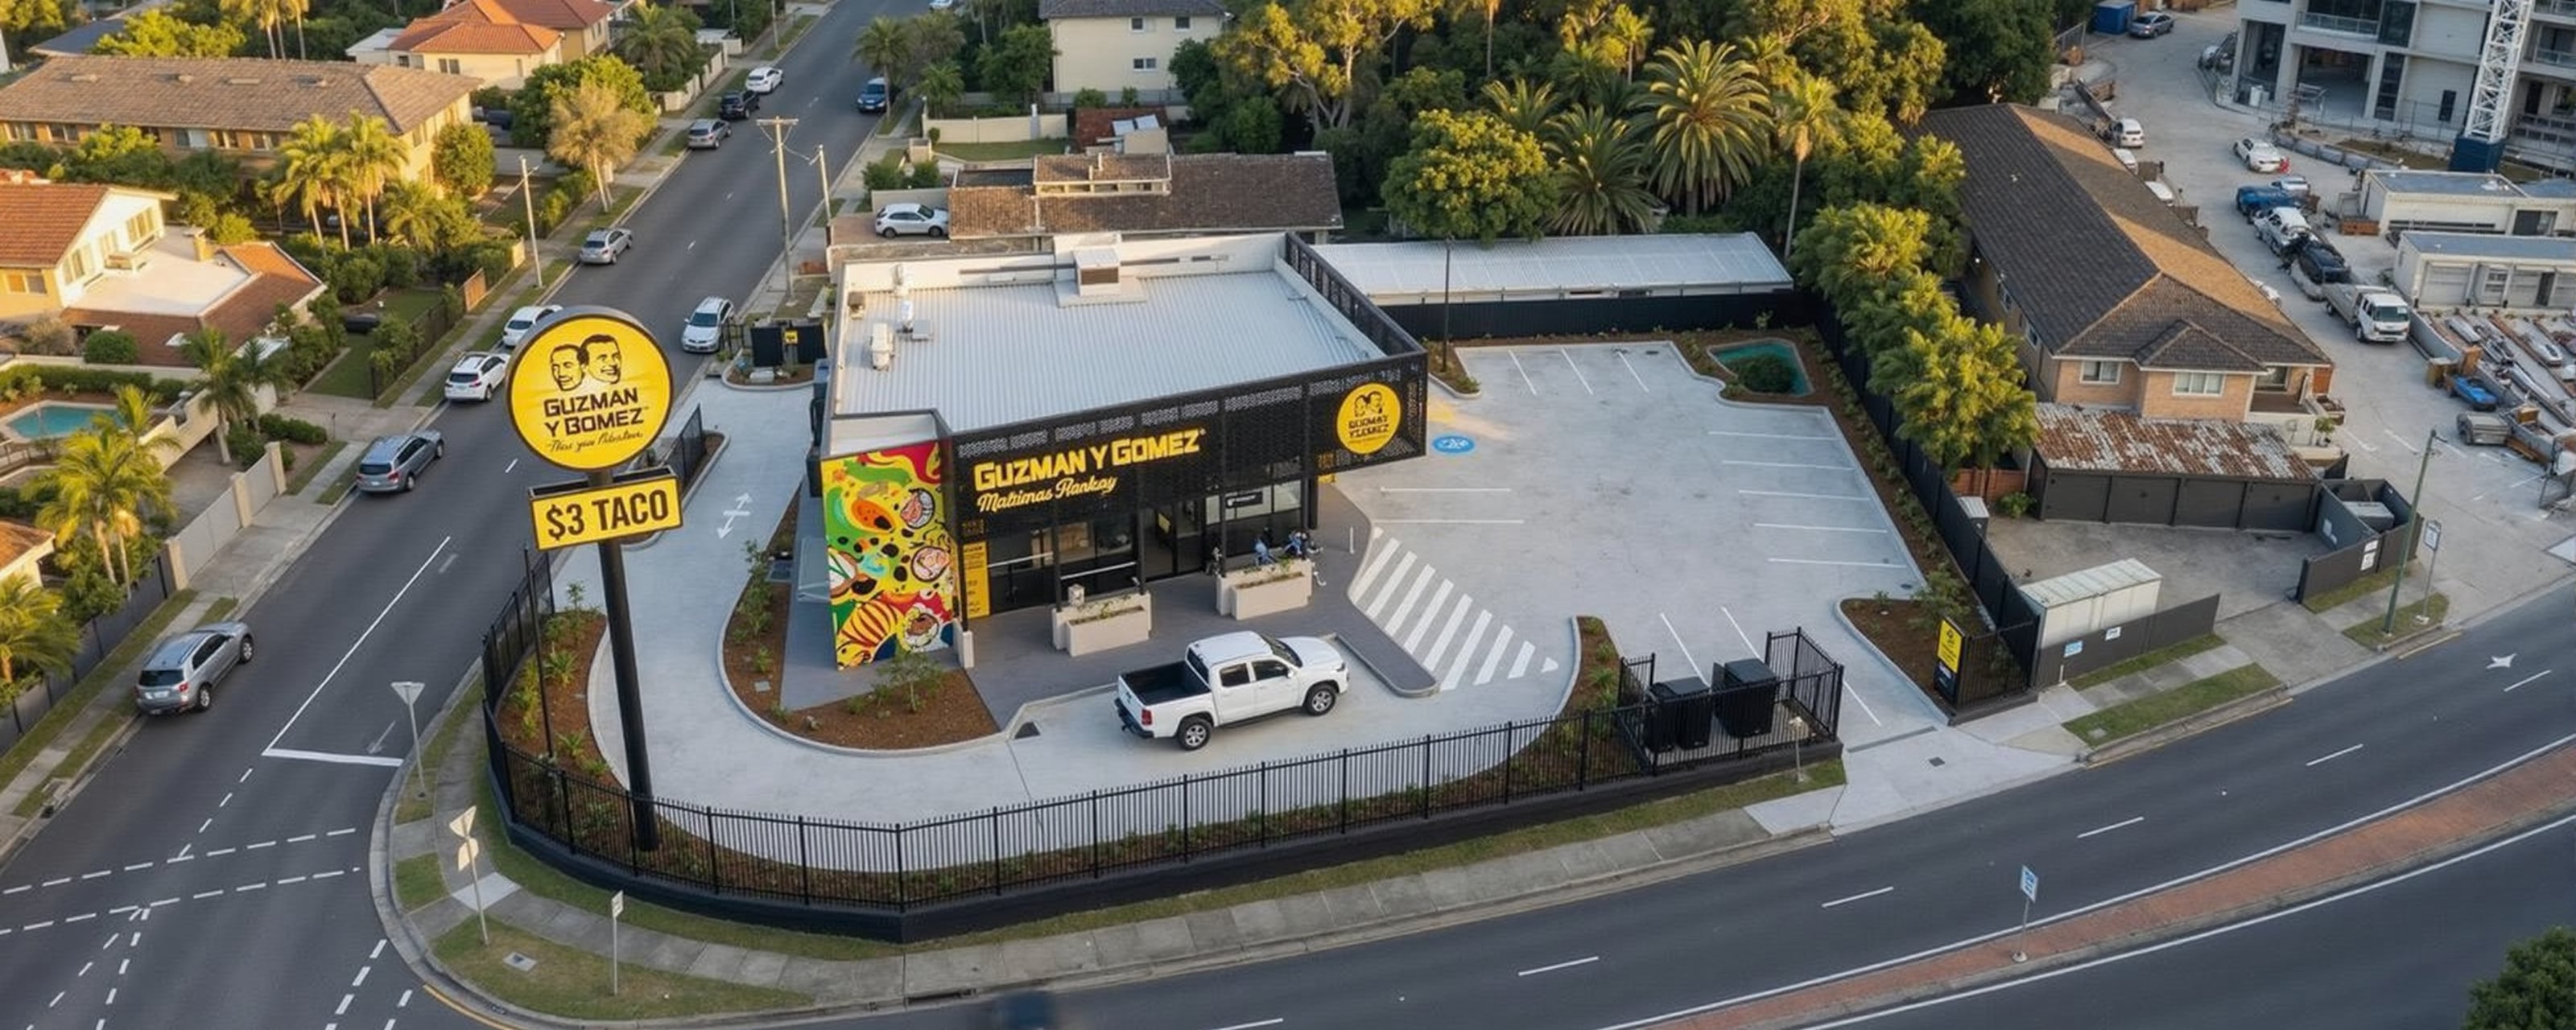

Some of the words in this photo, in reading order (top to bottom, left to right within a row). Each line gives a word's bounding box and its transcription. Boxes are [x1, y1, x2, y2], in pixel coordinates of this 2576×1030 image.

[543, 388, 638, 417] GUZMAN
[544, 421, 559, 437] Y
[974, 448, 1086, 491] GUZMAN
[1091, 444, 1108, 469] Y
[1112, 428, 1200, 466] GOMEZ
[546, 504, 584, 541] $3
[592, 489, 668, 531] TACO
